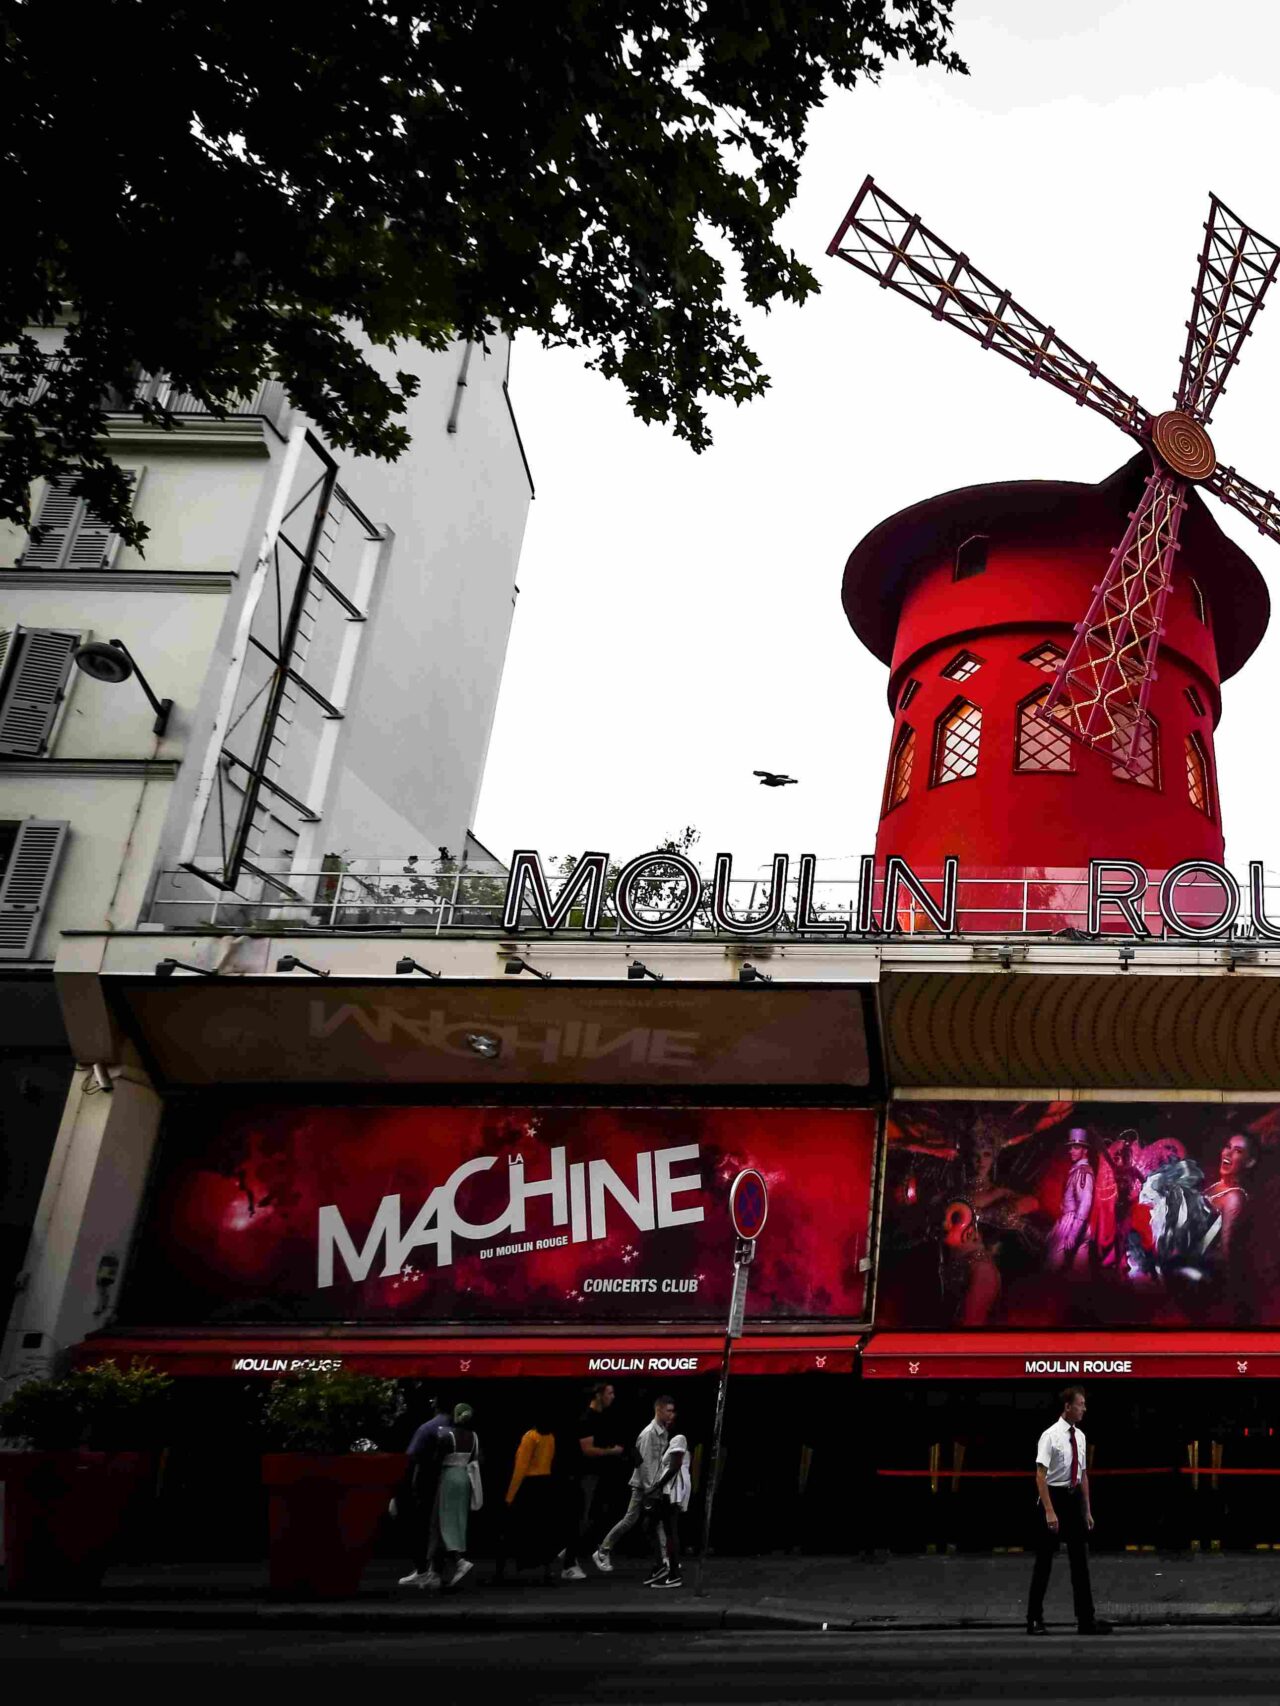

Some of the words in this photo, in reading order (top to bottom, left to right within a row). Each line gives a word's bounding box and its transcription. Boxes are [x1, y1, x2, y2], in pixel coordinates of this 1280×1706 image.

[503, 849, 959, 934] MOULIN
[508, 1153, 524, 1165] LA
[317, 1143, 705, 1288] MACHINE
[480, 1249, 493, 1260] DU
[496, 1241, 533, 1256] MOULIN
[536, 1235, 568, 1250] ROUGE
[583, 1279, 658, 1293] CONCERTS
[661, 1279, 699, 1293] CLUB
[232, 1359, 287, 1371] MOULIN
[589, 1358, 644, 1370] MOULIN
[648, 1358, 698, 1370] ROUGE
[1025, 1360, 1081, 1373] MOULIN
[1084, 1360, 1132, 1373] ROUGE
